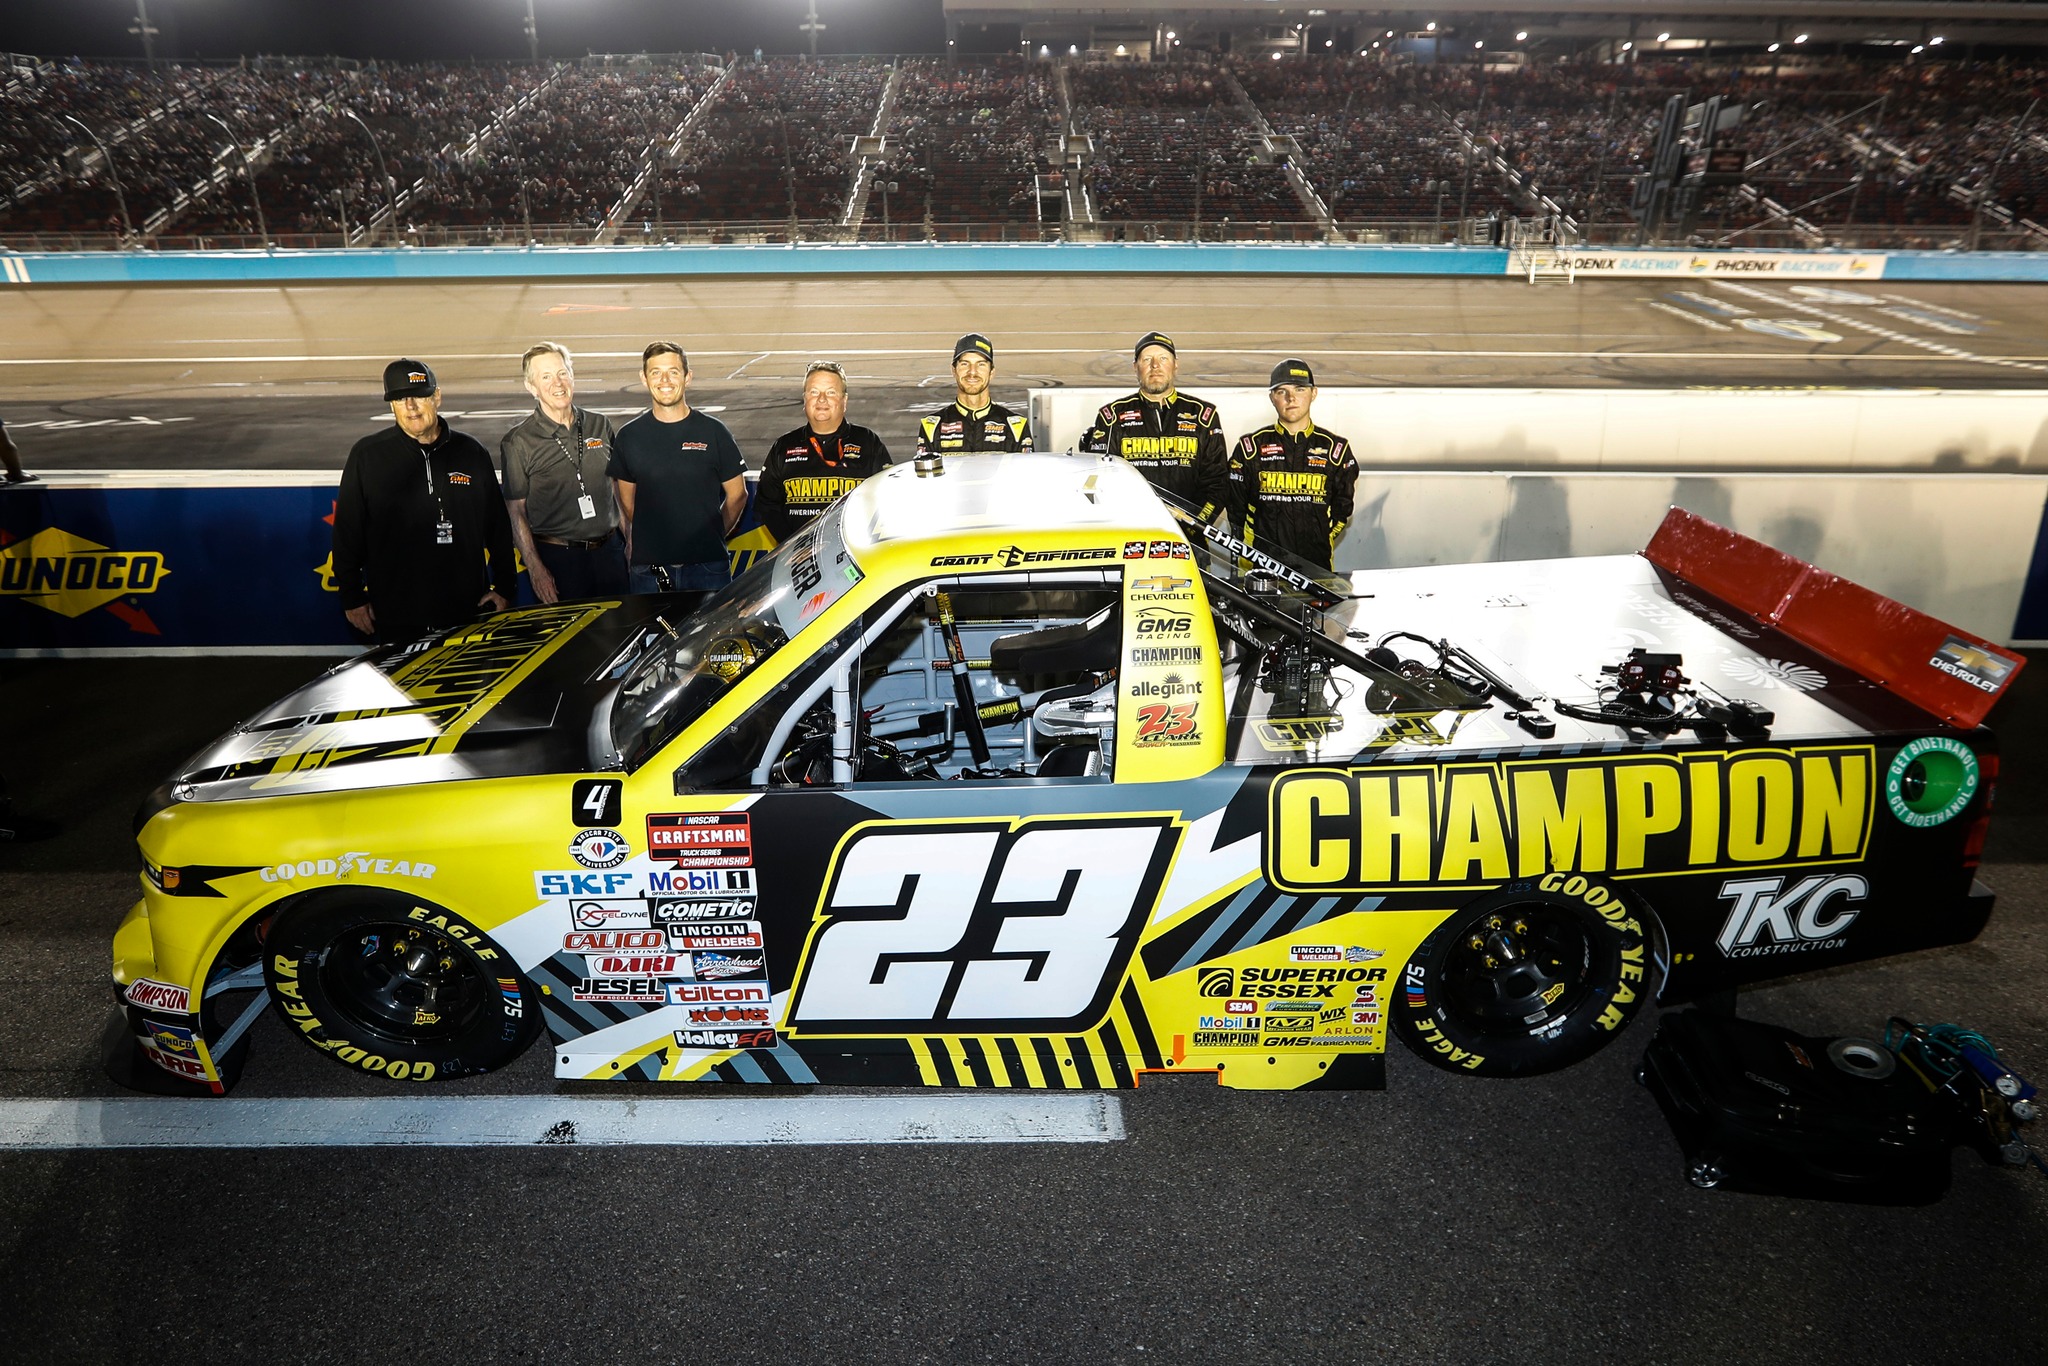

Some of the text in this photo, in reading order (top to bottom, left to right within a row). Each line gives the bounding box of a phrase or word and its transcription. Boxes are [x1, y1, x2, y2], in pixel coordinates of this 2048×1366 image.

[1552, 257, 1684, 272] PHOENIX RACEWAY
[1714, 259, 1845, 274] PHOENIX RACEWAY
[1122, 437, 1198, 454] CHAMPION
[930, 547, 1117, 567] GRANT ENFINGER
[1202, 524, 1314, 590] CHEVROLET
[0, 557, 158, 591] UNOCO
[1130, 593, 1195, 601] CHEVROLET
[1136, 618, 1192, 633] GMS
[709, 654, 743, 663] CHAMPION
[1132, 647, 1201, 662] CHAMPION
[967, 660, 992, 669] CHAMP
[1929, 656, 2000, 693] CHEVROLET
[1131, 681, 1202, 699] allegiant
[979, 701, 1019, 717] CHAMPION
[1136, 701, 1199, 737] 23
[1891, 736, 1976, 775] GET BIOETHANOL
[582, 785, 612, 820] 4
[1890, 789, 1974, 827] GET BIOETHANOL
[688, 816, 720, 825] NASCAR
[1279, 754, 1866, 883] CHAMPION
[576, 830, 620, 844] NASCAR 75TH
[653, 829, 746, 844] CRAFTSMAN
[576, 853, 624, 868] ANNIVERSARY
[680, 848, 722, 857] TRUCK SERIES
[682, 857, 750, 867] CHAMPIONSHIP
[541, 873, 633, 896] SKF
[650, 871, 742, 891] Mobil 1
[576, 910, 648, 922] XCELDYNE
[657, 901, 753, 918] COMETIC
[1716, 873, 1870, 957] TKC
[673, 925, 746, 937] LINCOLN
[795, 826, 1163, 1020] 23
[408, 906, 500, 962] EAGLE
[564, 931, 666, 949] CALICO
[690, 937, 756, 947] WELDERS
[1539, 872, 1645, 1031] GOODYEAR
[1731, 938, 1847, 958] CONSTRUCTION
[601, 954, 683, 973] DART
[694, 952, 763, 968] Arrowhead
[1240, 968, 1387, 982] SUPERIOR
[1406, 963, 1425, 986] 75
[573, 978, 665, 995] JESEL
[675, 986, 764, 1002] tilton
[1239, 984, 1338, 998] ESSEX
[128, 981, 189, 1010] SIMPSON
[503, 998, 523, 1019] 75
[688, 1006, 769, 1022] KOOKS
[1228, 1002, 1253, 1012] SEM
[1320, 1006, 1347, 1020] WIX
[273, 954, 436, 1081] GOODYEAR
[1200, 1016, 1243, 1028] Mobil
[1354, 1012, 1377, 1023] 3M
[1194, 1032, 1259, 1043] CHAMPION
[1324, 1026, 1373, 1035] ARLON
[154, 1033, 193, 1049] SUNOCO
[676, 1030, 774, 1049] Holley EFI
[1263, 1036, 1312, 1047] GMS
[1414, 1017, 1486, 1070] EAGLE
